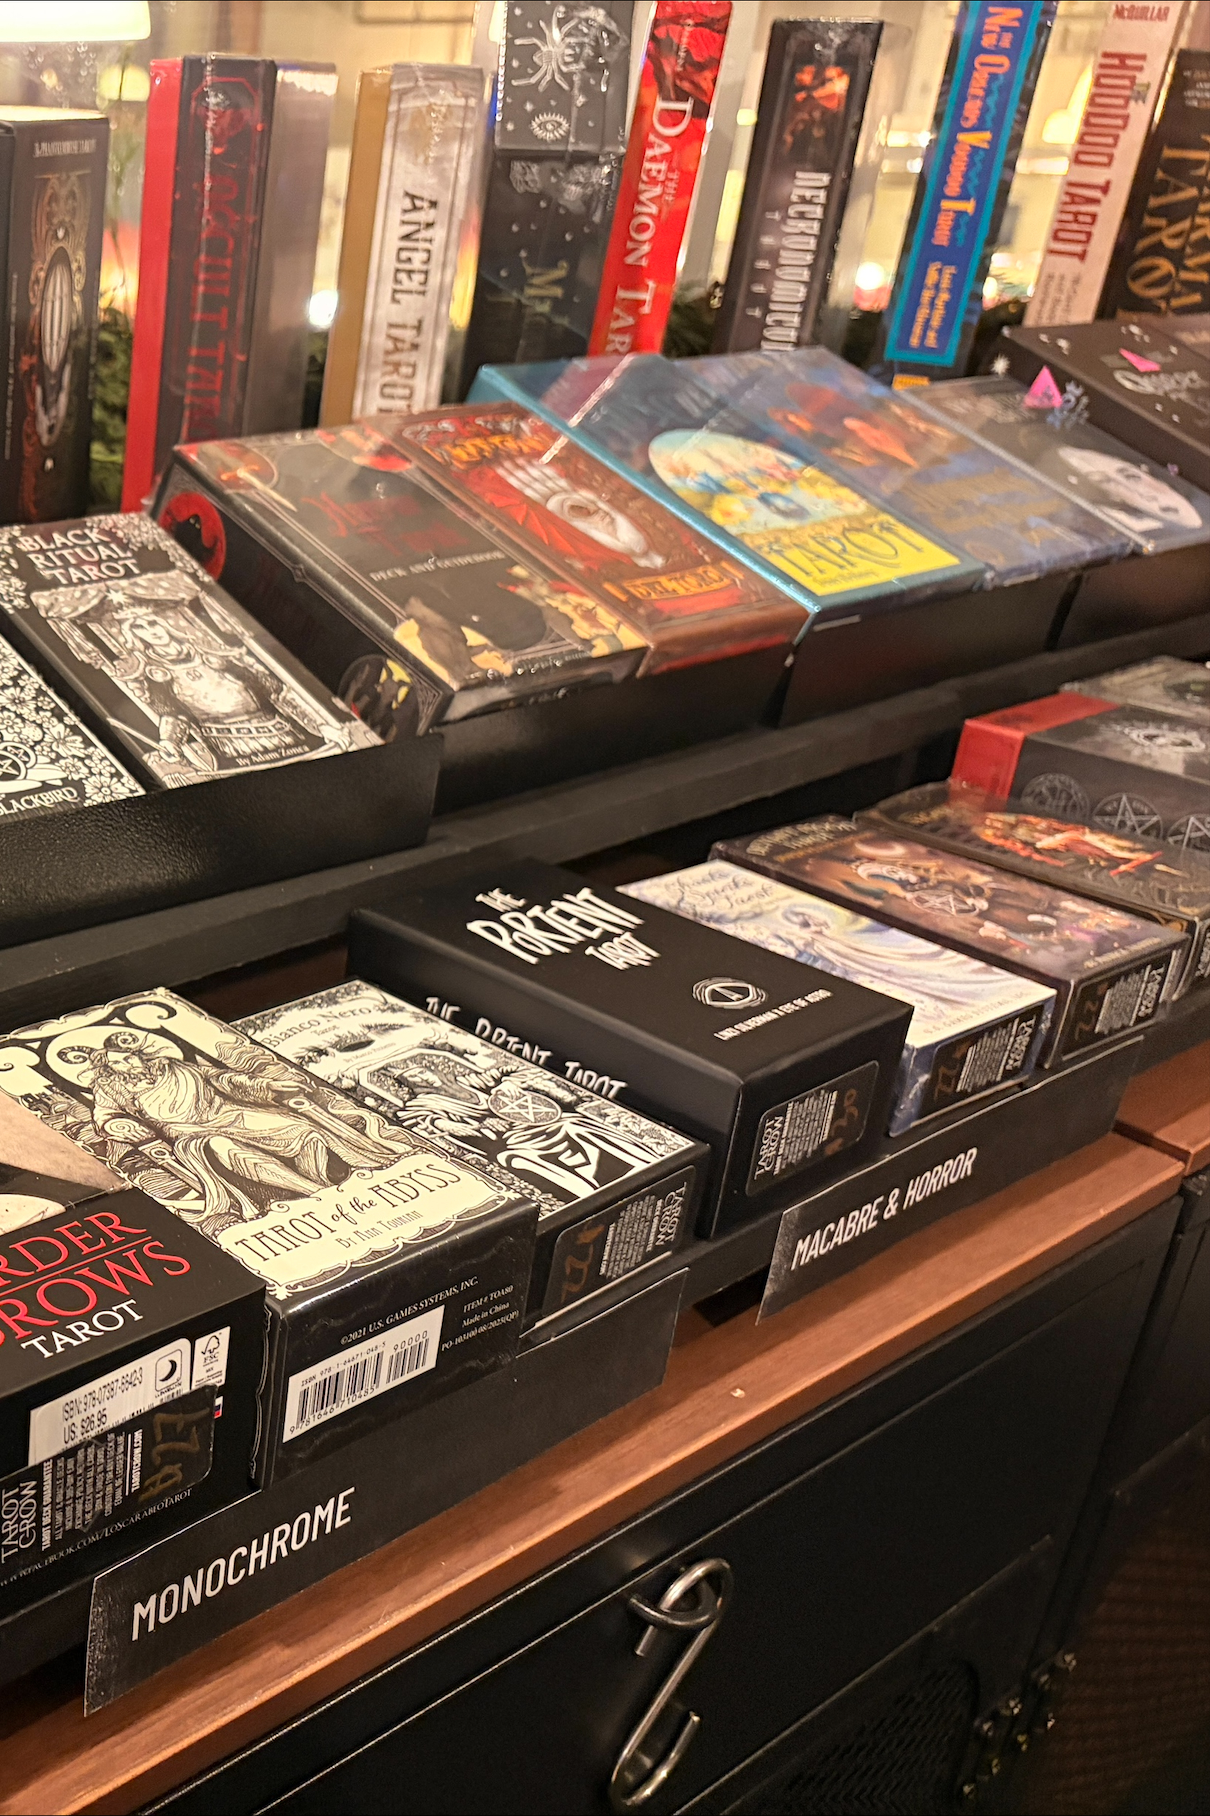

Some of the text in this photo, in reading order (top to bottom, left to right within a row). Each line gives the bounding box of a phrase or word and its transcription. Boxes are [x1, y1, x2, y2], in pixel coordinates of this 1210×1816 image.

[1073, 51, 1147, 168] HOODOO
[944, 131, 992, 197] VOODOO
[392, 189, 438, 304] ANGEL
[605, 98, 694, 354] DAEMON TAR
[1045, 180, 1112, 263] TAROT
[1126, 134, 1210, 308] TARO
[194, 176, 239, 330] OCCULT
[16, 528, 111, 551] BLACK
[27, 543, 133, 568] RITUAL
[759, 521, 924, 577] TAROT
[46, 558, 140, 585] TAROT
[466, 886, 644, 964] PORTENT
[475, 887, 525, 912] THE
[585, 933, 661, 970] TAROT
[260, 1006, 372, 1048] Bianco Nero
[310, 1024, 340, 1037] Tarot
[754, 1118, 775, 1180] TAROT
[764, 1116, 784, 1171] CROW
[234, 1163, 463, 1262] TAROT of the ABYSS
[655, 1192, 675, 1246] CROW
[665, 1181, 687, 1241] TAROT
[790, 1147, 978, 1271] MACABRE & HORROR
[20, 1298, 144, 1359] TAROT
[368, 1322, 384, 1334] U.S.
[386, 1305, 418, 1326] GAMES
[418, 1288, 458, 1311] SYSTEMS,
[460, 1276, 479, 1293] INC.
[462, 1301, 510, 1328] Made in China
[463, 1298, 483, 1314] ITEM
[204, 1352, 219, 1363] FSC
[393, 1330, 428, 1353] 90000
[300, 1406, 336, 1429] 781646
[339, 1386, 375, 1408] 710485
[301, 1374, 317, 1387] ISBN
[62, 1399, 83, 1422] ISBN:
[63, 1408, 108, 1444] US: $26.95
[130, 1428, 142, 1492] TAROTCROW.COM
[2, 1488, 19, 1564] TAROT
[18, 1480, 37, 1548] CROW
[40, 1457, 54, 1551] TAROT DECK GUARANTEE
[131, 1486, 355, 1642] MONOCHROME
